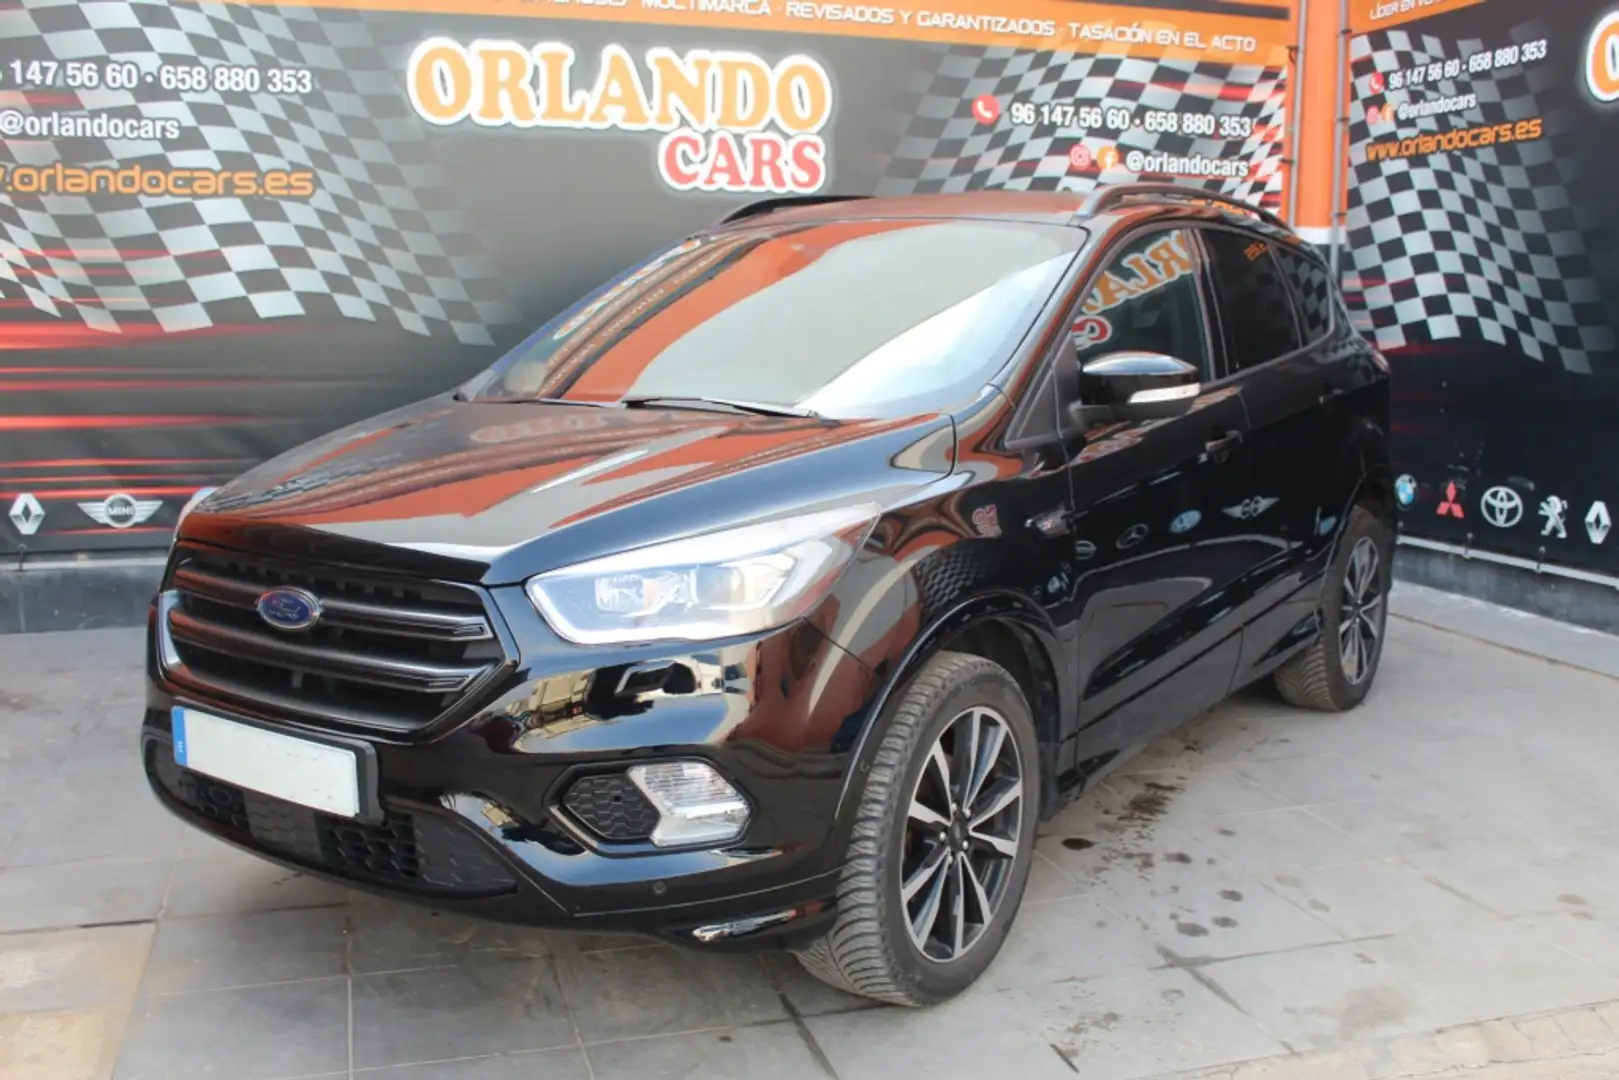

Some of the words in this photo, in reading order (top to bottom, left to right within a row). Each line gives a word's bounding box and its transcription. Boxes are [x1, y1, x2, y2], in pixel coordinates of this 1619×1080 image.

[787, 1, 894, 25] REVISADOS
[899, 10, 912, 25] Y
[917, 10, 1055, 37] GARANTIZADOS
[1068, 21, 1152, 44] TASACIÓN
[1156, 29, 1180, 46] EN
[1184, 31, 1207, 49] EL
[1211, 34, 1257, 52] ACTO
[9, 60, 58, 86] 147
[66, 62, 99, 88] 56
[105, 63, 138, 89] 60
[160, 65, 207, 91] 658
[214, 67, 260, 93] 880
[267, 69, 313, 94] 353
[1389, 71, 1403, 90] 96
[1405, 66, 1426, 87] 147
[1428, 61, 1443, 81] 56
[1445, 58, 1460, 78] 60
[1469, 52, 1492, 73] 658
[1494, 46, 1519, 67] 880
[1521, 39, 1548, 62] 353
[408, 36, 832, 135] ORLANDO
[1011, 102, 1035, 126] 96
[1040, 104, 1074, 128] 147
[1079, 106, 1103, 129] 56
[1107, 108, 1130, 131] 60
[1144, 111, 1177, 133] 658
[1182, 113, 1215, 135] 880
[1219, 115, 1252, 138] 353
[1397, 92, 1476, 120] @orlandocars
[0, 109, 180, 140] @orlandocars
[1366, 117, 1543, 161] www.orlandocars.es
[659, 128, 826, 194] CARS
[1125, 151, 1249, 179] @orlandocars
[0, 162, 314, 197] .orlandocars.es
